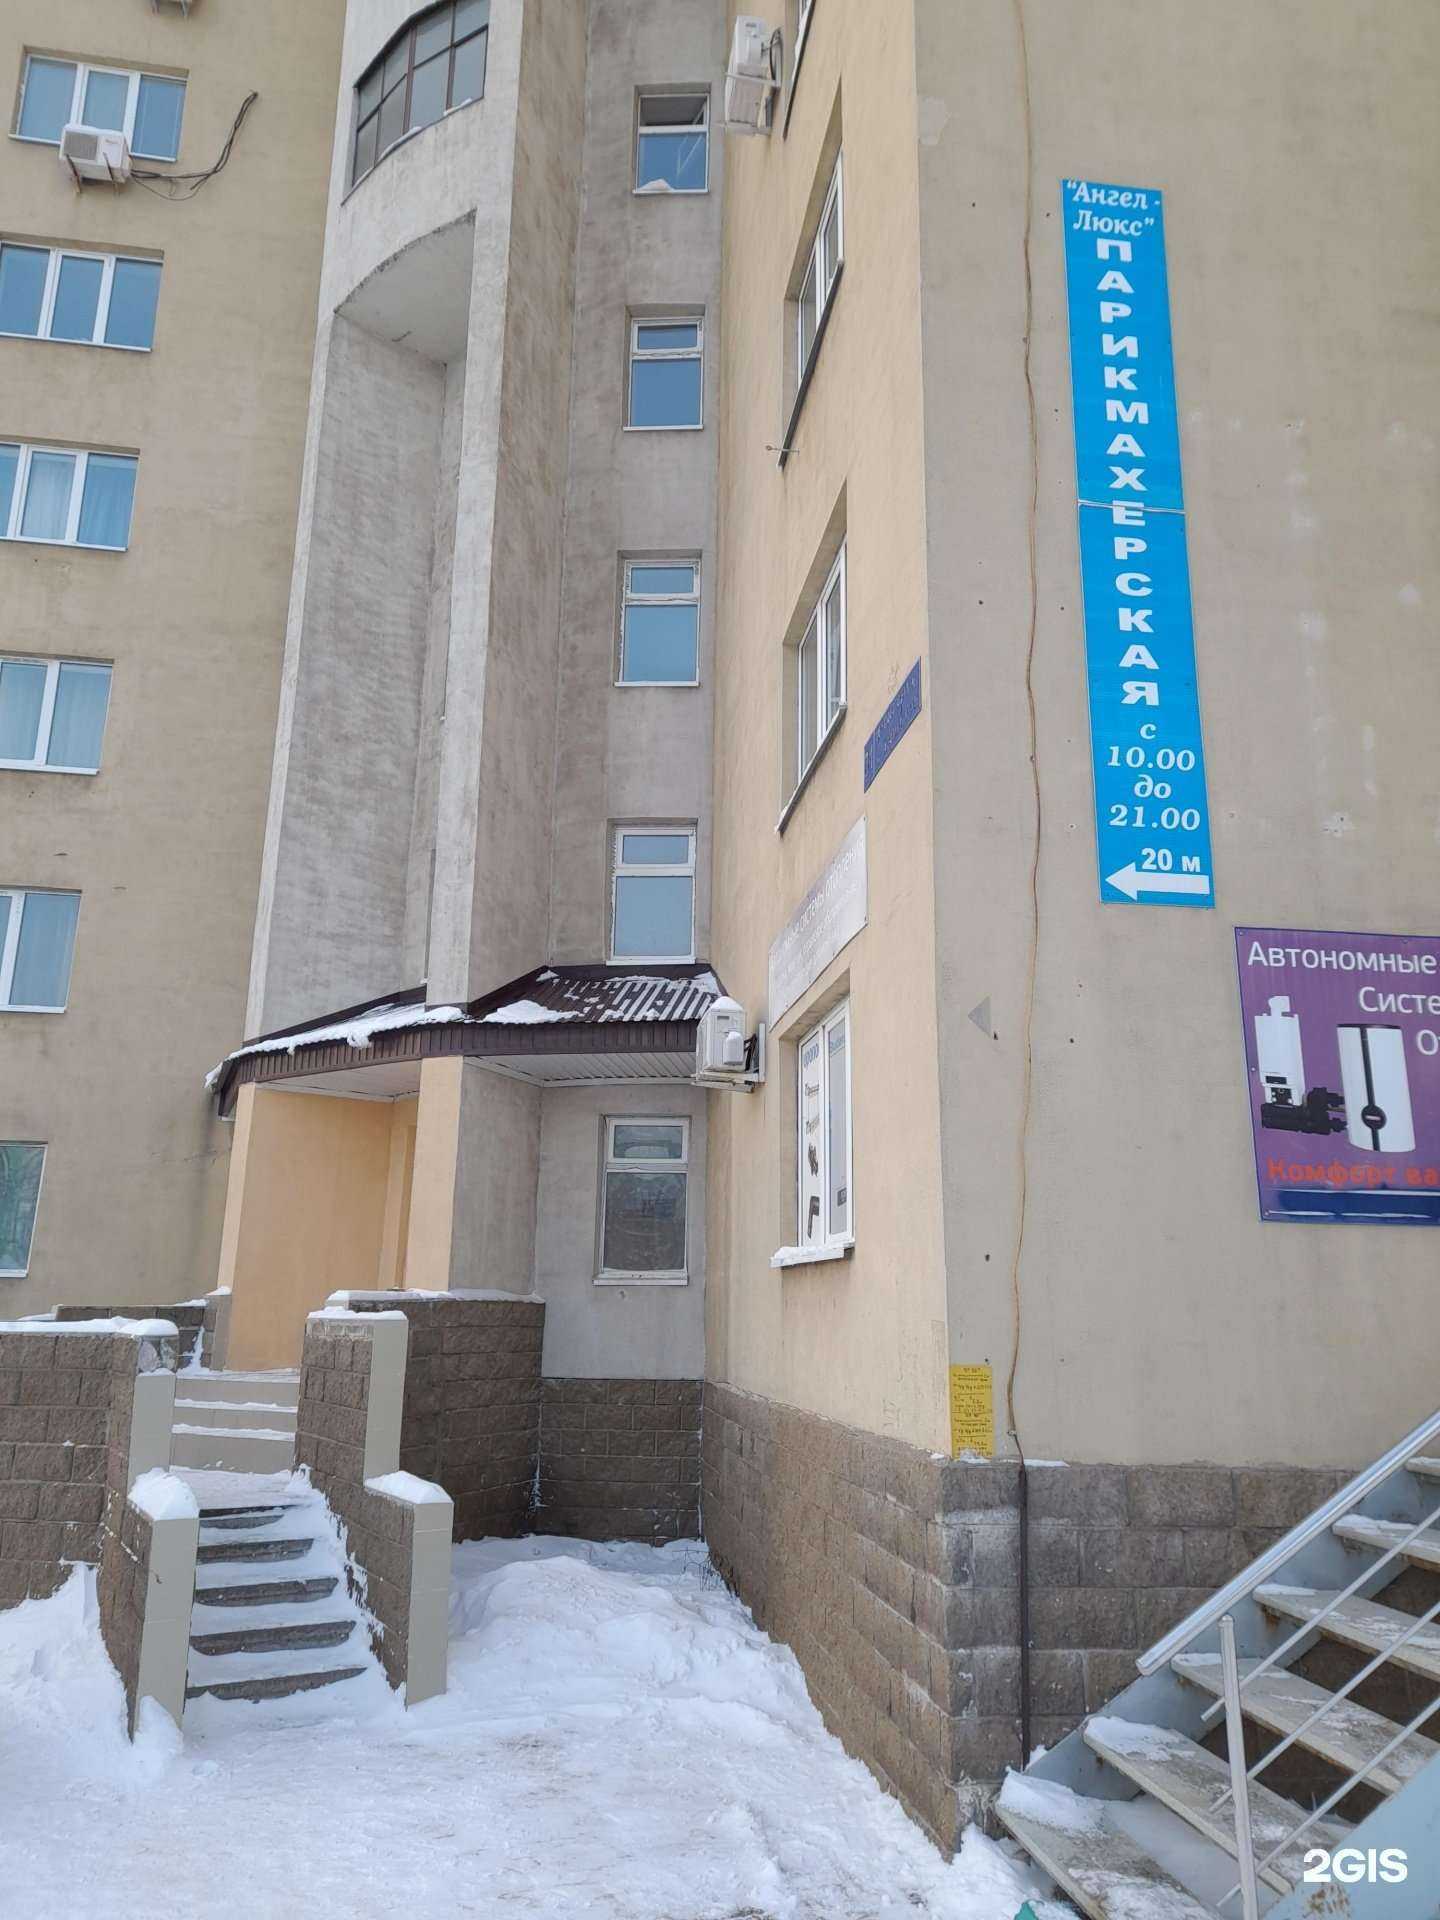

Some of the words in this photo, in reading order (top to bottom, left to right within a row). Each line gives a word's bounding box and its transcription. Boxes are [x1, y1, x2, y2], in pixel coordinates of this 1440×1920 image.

[1096, 238, 1160, 706] ПАРИКМАХЕРСКАЯ
[1140, 723, 1157, 740] с
[1108, 745, 1196, 771] 10.00
[1133, 774, 1172, 799] до
[1109, 804, 1201, 831] 21.00
[1141, 847, 1173, 871] 20
[1248, 941, 1437, 974] Автономные
[1416, 1029, 1440, 1056] О
